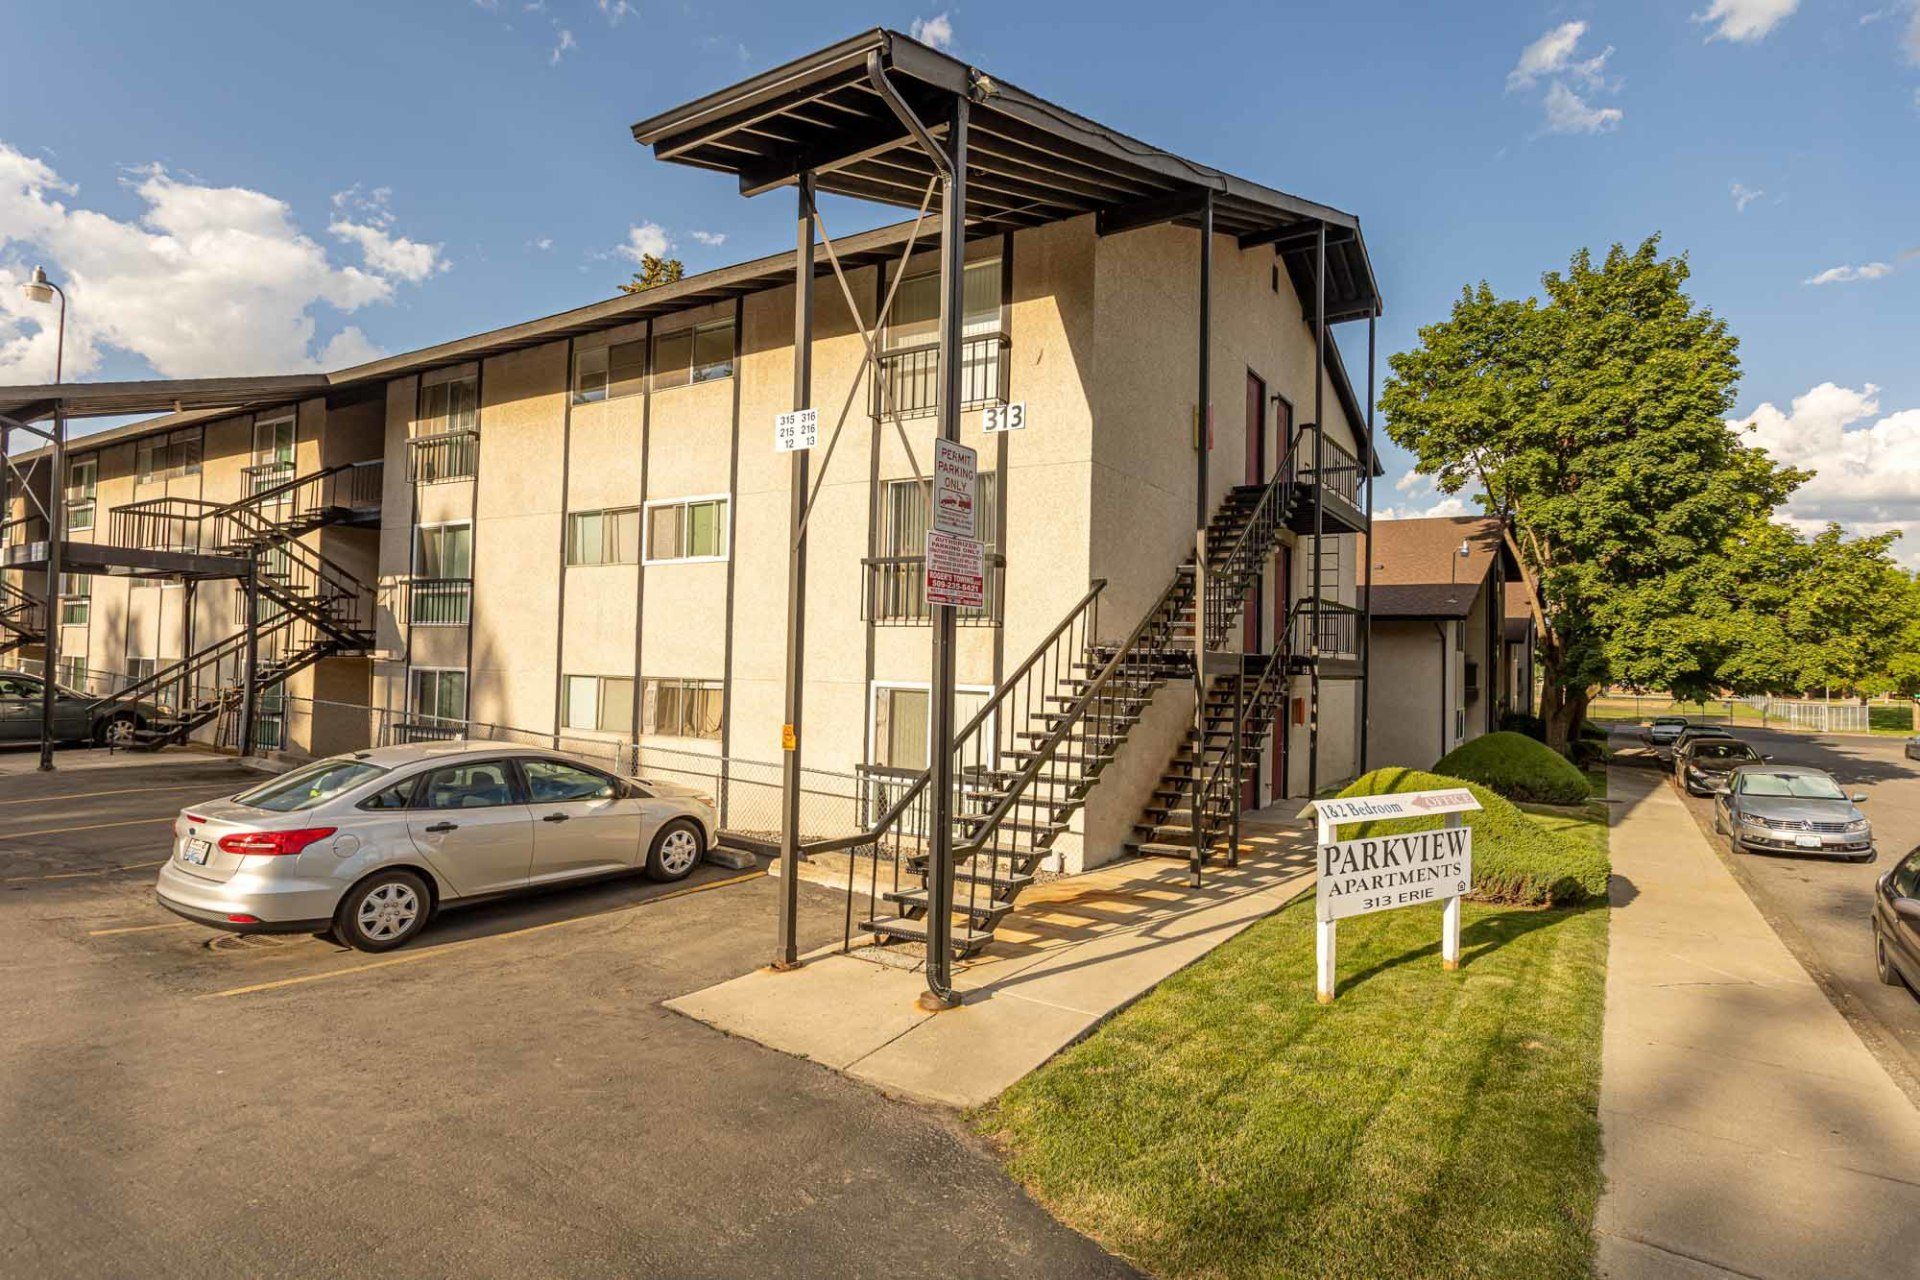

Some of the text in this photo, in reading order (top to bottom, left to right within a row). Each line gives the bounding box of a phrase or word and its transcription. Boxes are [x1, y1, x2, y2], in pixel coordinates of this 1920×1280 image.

[780, 411, 815, 425] 315 316
[985, 404, 1022, 431] 313
[780, 423, 815, 437] 215 216
[785, 436, 815, 448] 12 13
[941, 448, 971, 466] PERMIT
[938, 461, 973, 480] PARKING
[945, 477, 967, 491] ONLY
[932, 541, 960, 551] PARKING
[963, 547, 980, 555] ONLY
[935, 537, 977, 549] AUTHORIZED
[1349, 802, 1404, 817] Bedroom
[1323, 829, 1468, 877] PARKVIEW
[1328, 862, 1462, 897] APARTMENTS
[1363, 888, 1434, 910] 313 ERIE
